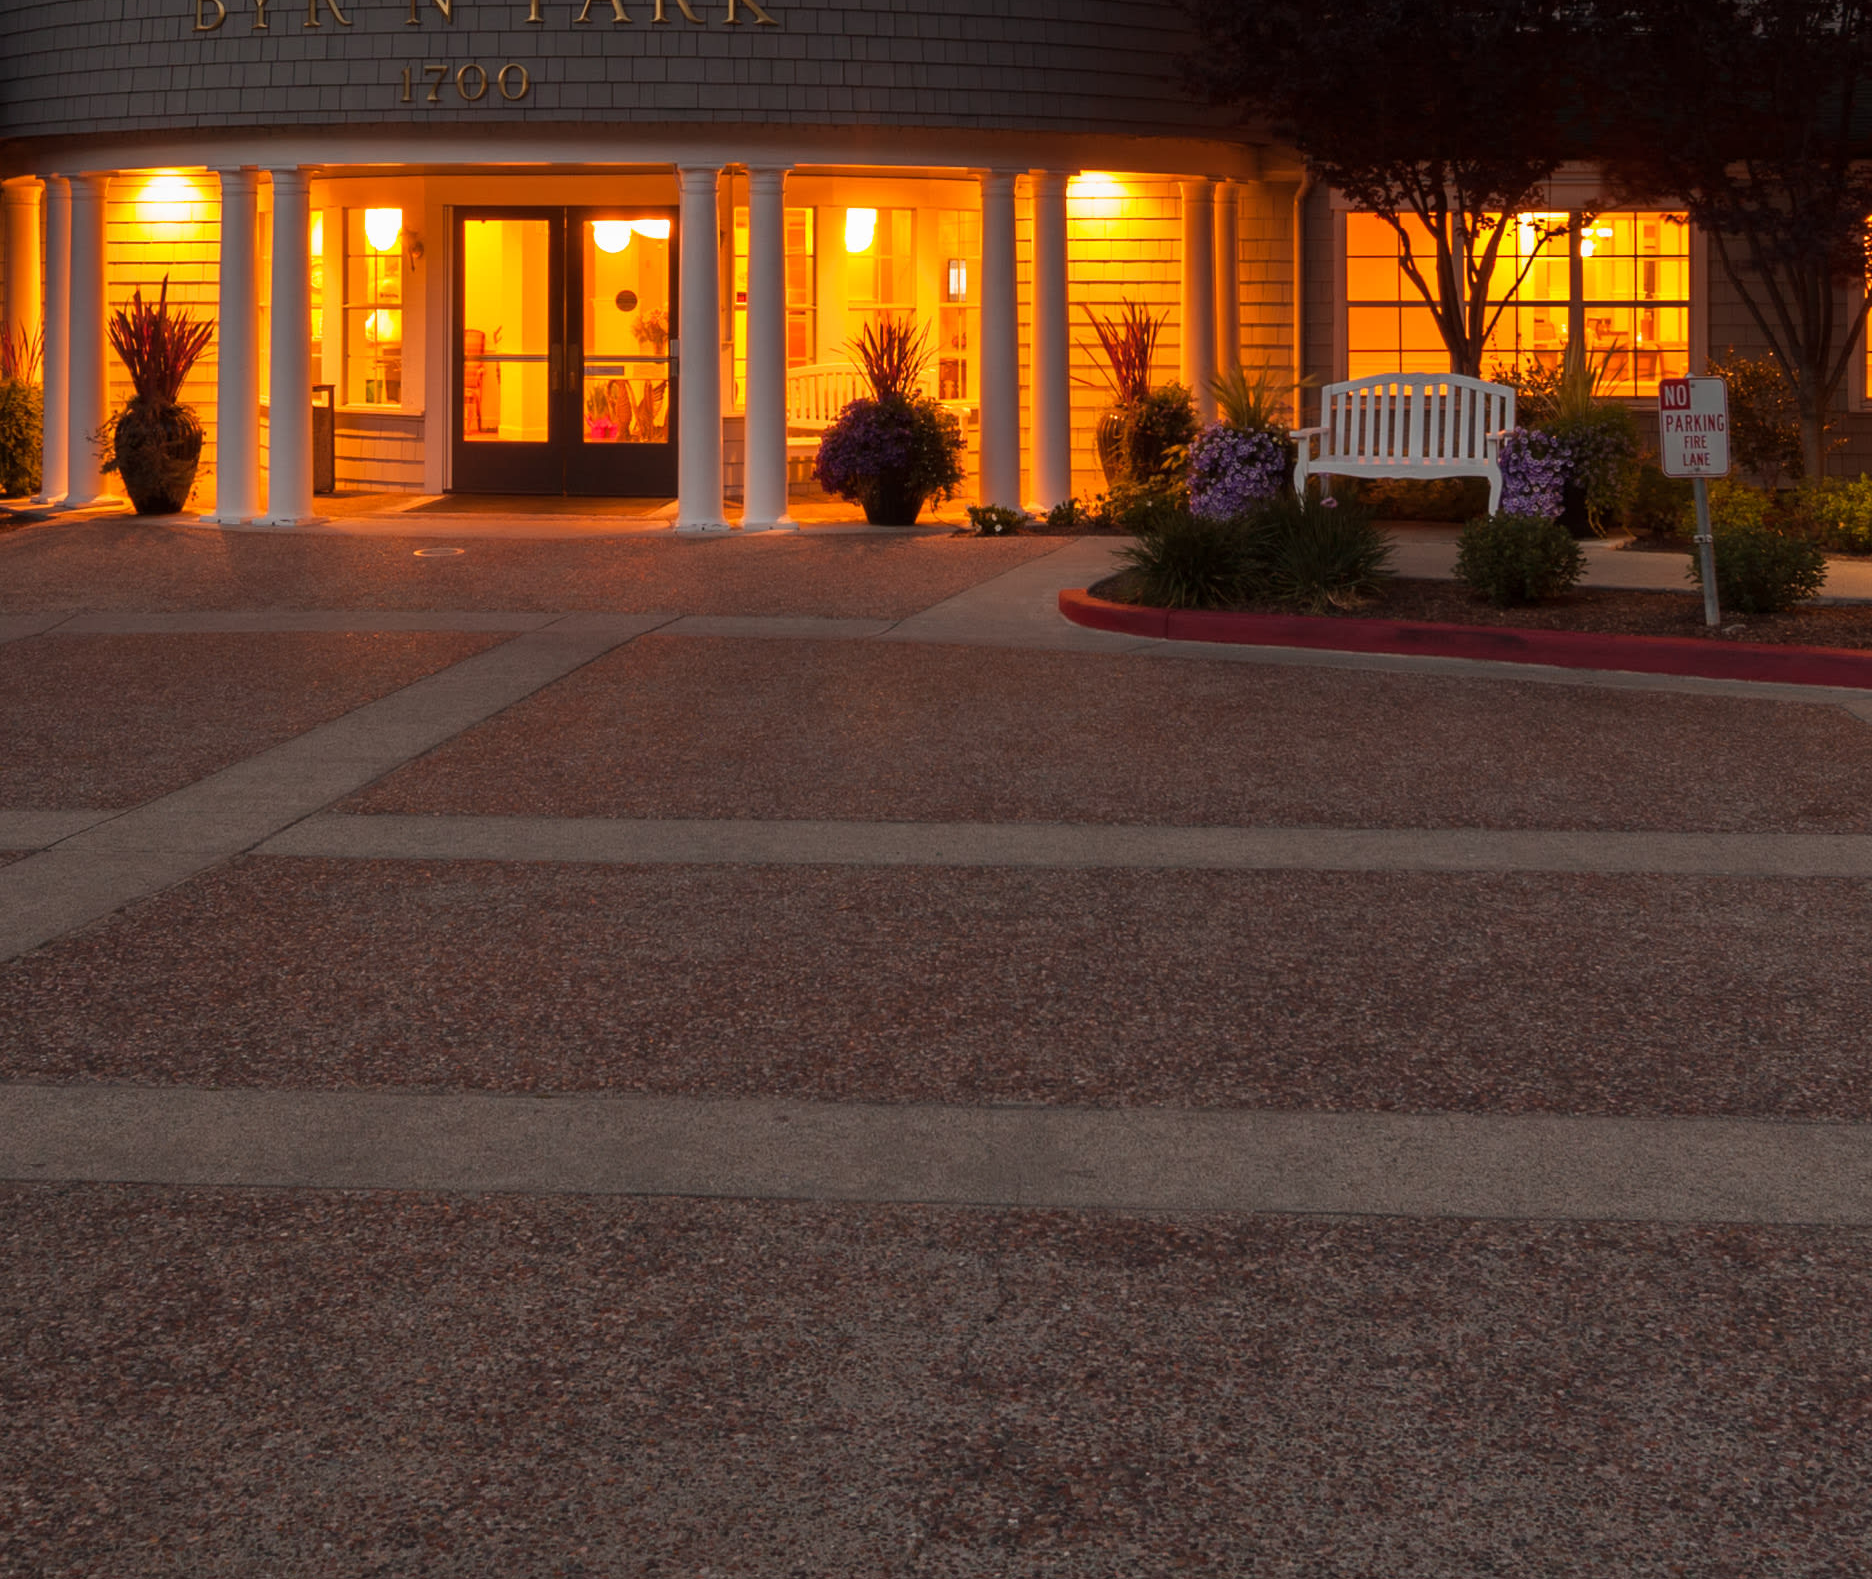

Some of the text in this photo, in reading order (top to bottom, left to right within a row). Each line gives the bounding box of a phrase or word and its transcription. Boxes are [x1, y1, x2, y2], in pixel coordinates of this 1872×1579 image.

[400, 63, 530, 102] 1700
[1664, 384, 1687, 407] NO
[1665, 413, 1725, 433] PARKING
[1684, 435, 1708, 449] FIRE
[1682, 452, 1711, 467] LANE
